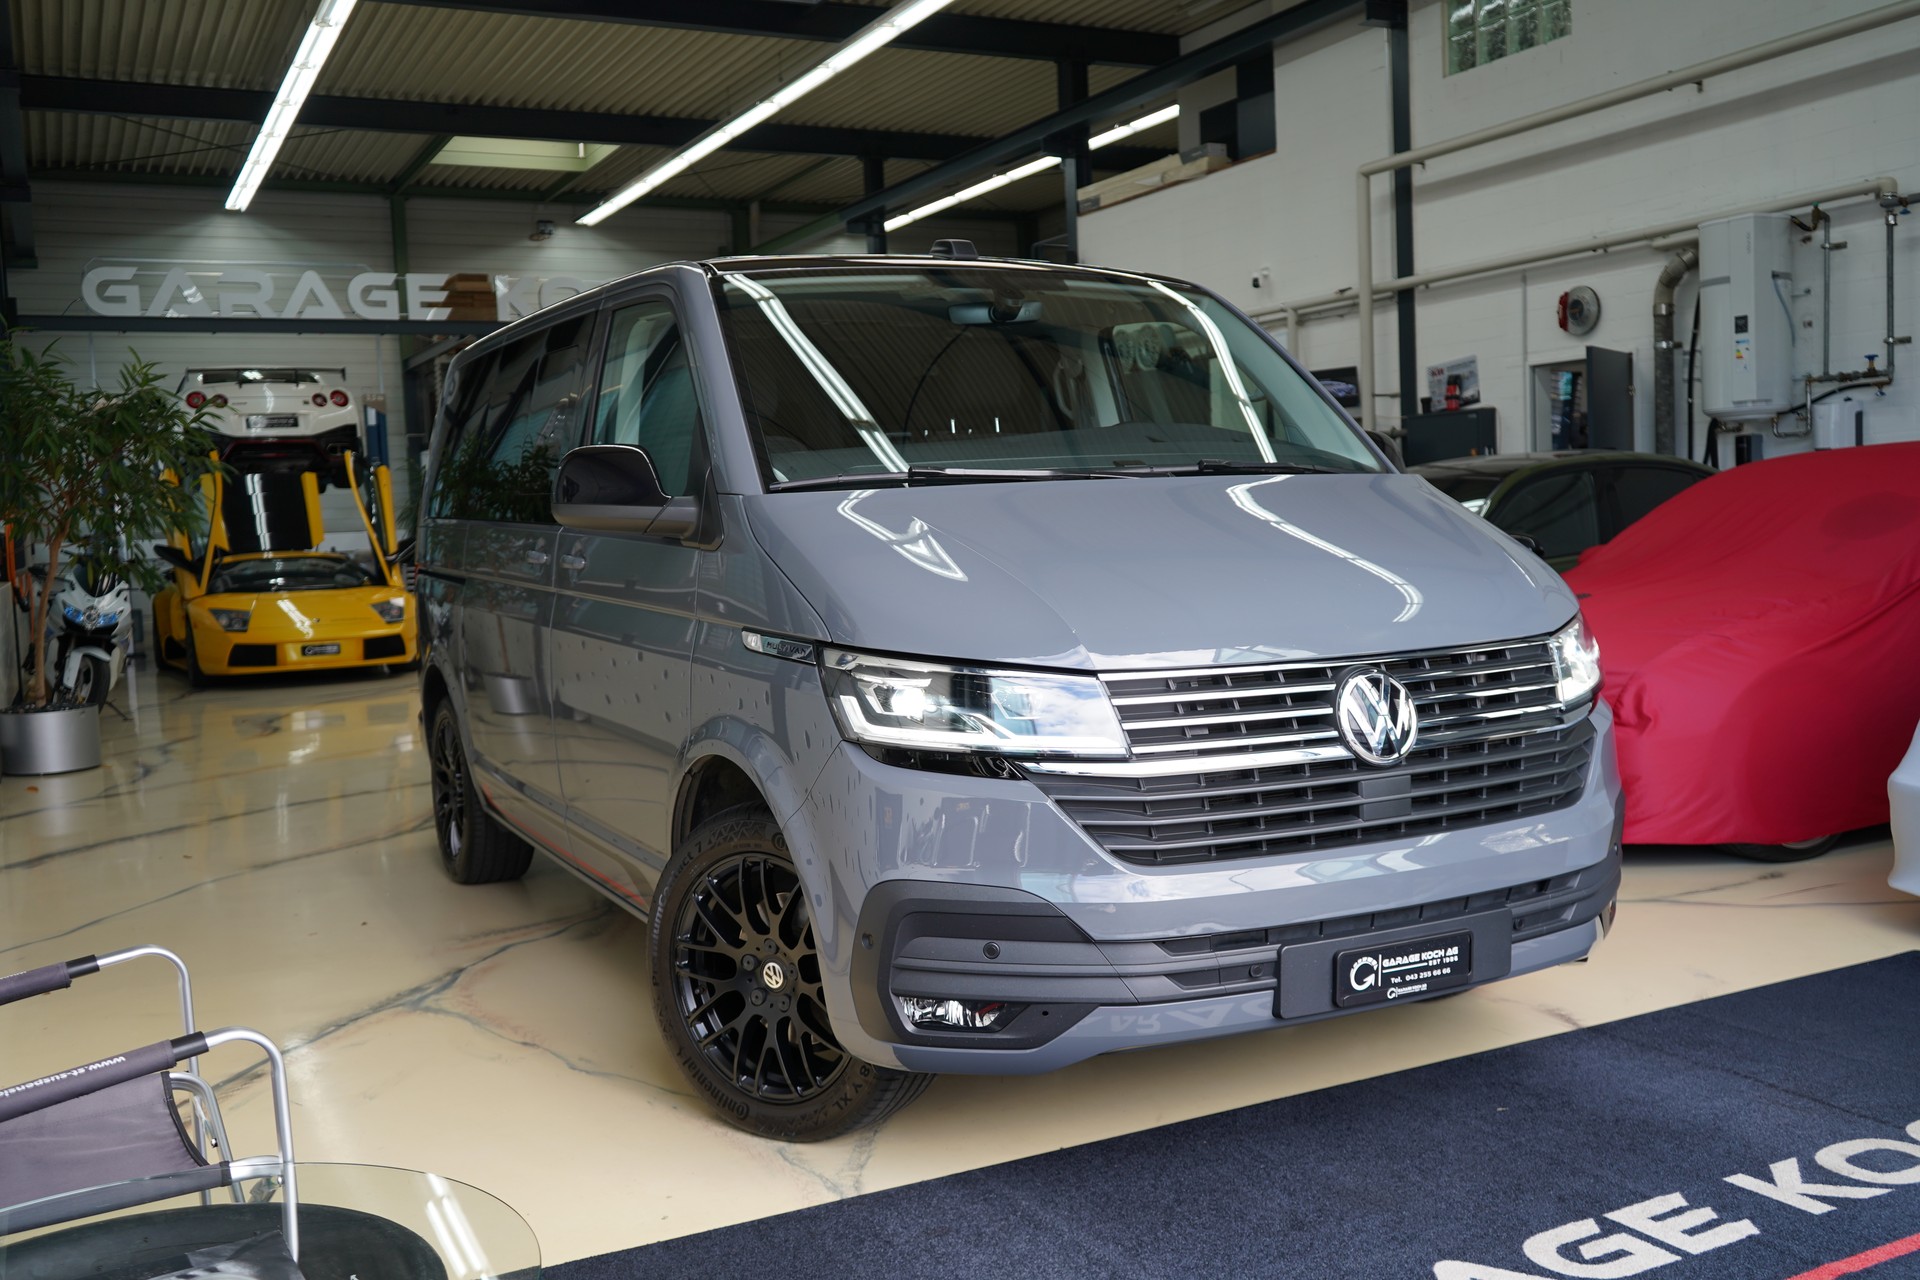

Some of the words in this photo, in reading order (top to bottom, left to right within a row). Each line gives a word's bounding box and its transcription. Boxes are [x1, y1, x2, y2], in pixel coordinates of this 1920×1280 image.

[81, 266, 453, 320] GARAGE
[1382, 953, 1421, 967] GARAGE
[1421, 948, 1445, 961] KOCH
[1445, 946, 1459, 957] AG
[1428, 959, 1441, 967] EST
[1390, 976, 1403, 984] Tel.
[1405, 973, 1418, 981] 043
[1419, 971, 1432, 979] 255
[682, 1057, 750, 1121] Continental
[1722, 1120, 1920, 1215] KO
